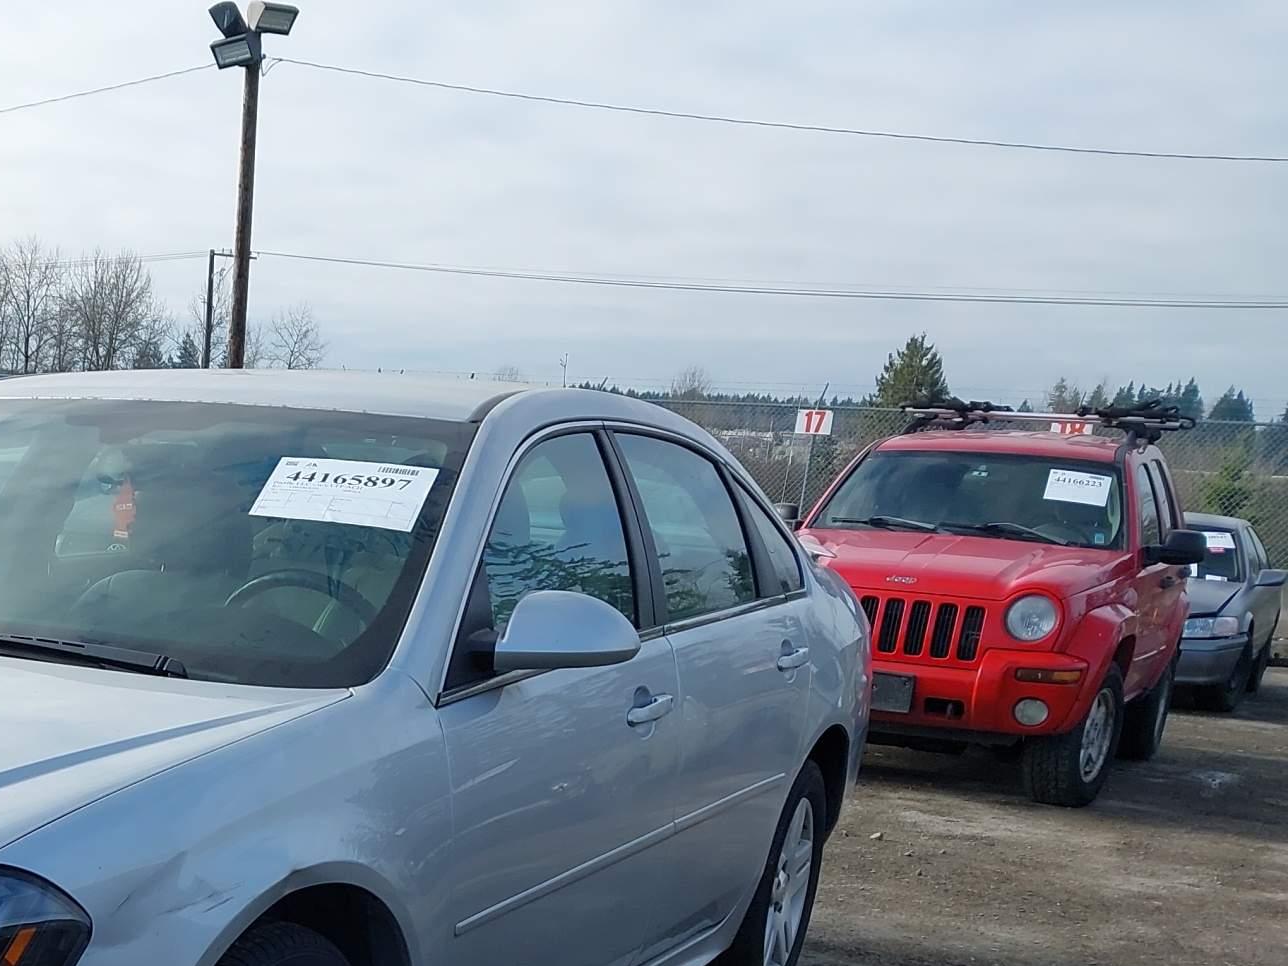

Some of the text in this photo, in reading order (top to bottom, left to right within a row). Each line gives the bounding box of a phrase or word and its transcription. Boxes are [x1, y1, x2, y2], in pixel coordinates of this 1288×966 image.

[804, 411, 826, 433] 17
[286, 470, 413, 491] 44165897
[1054, 476, 1103, 488] 44166223
